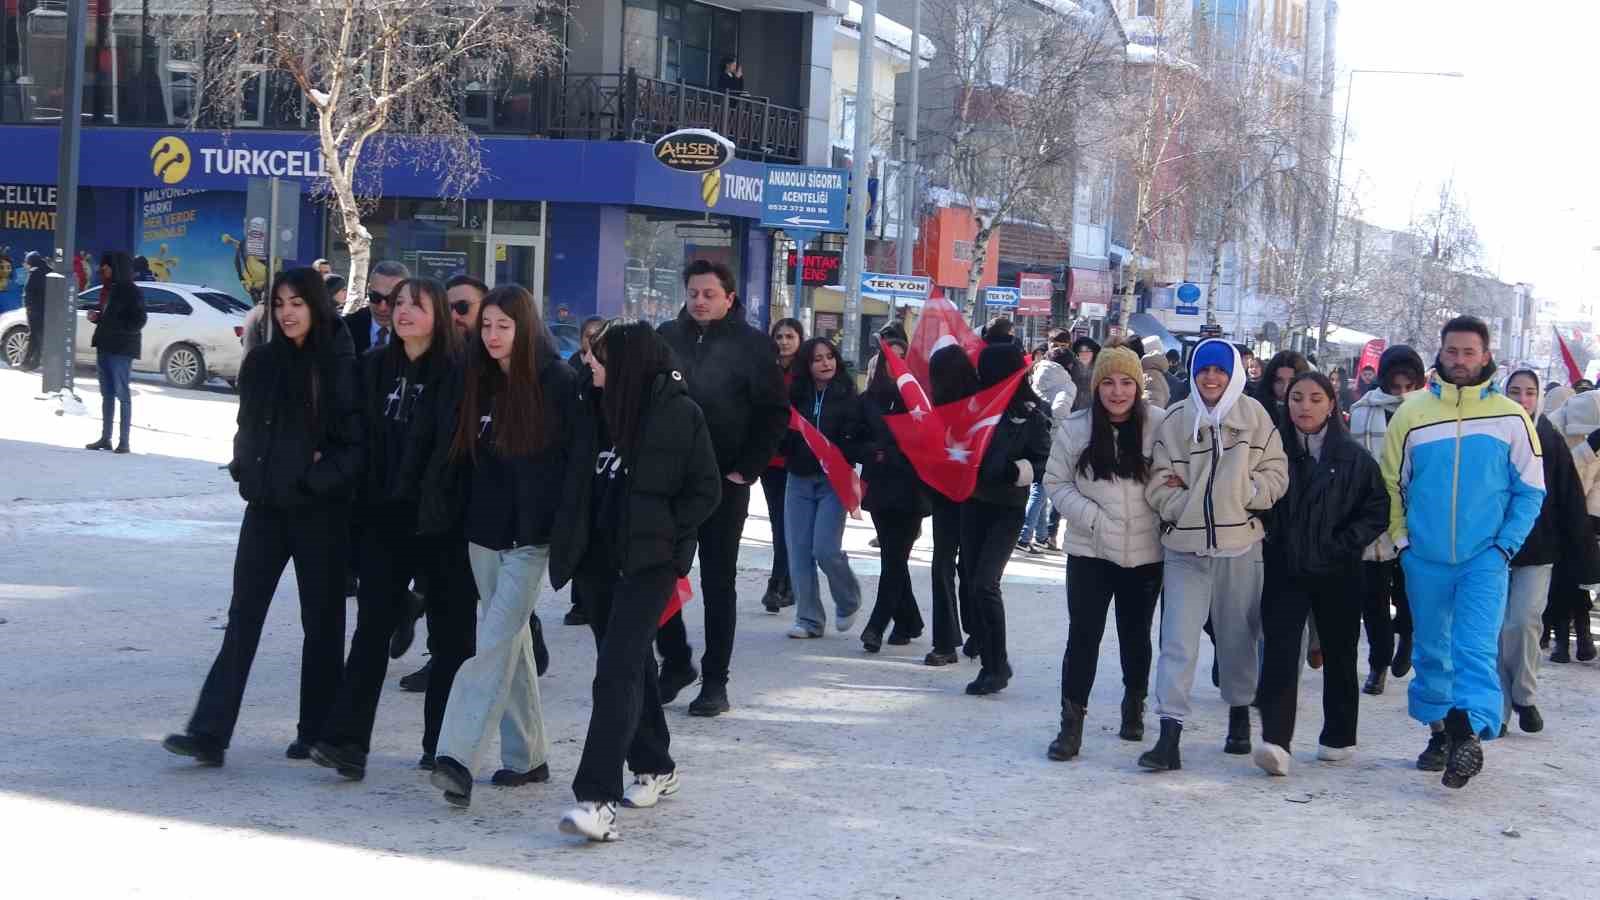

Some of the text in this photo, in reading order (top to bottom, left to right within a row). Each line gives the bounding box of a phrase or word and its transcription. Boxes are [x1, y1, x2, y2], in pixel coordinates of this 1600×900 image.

[658, 142, 718, 157] AHSEN
[200, 149, 333, 177] TURKCELL
[768, 170, 842, 190] ANADOLU SİGORTA
[782, 191, 829, 204] ACENTELİĞİ
[788, 255, 840, 269] KNTAK
[870, 280, 894, 289] TEK
